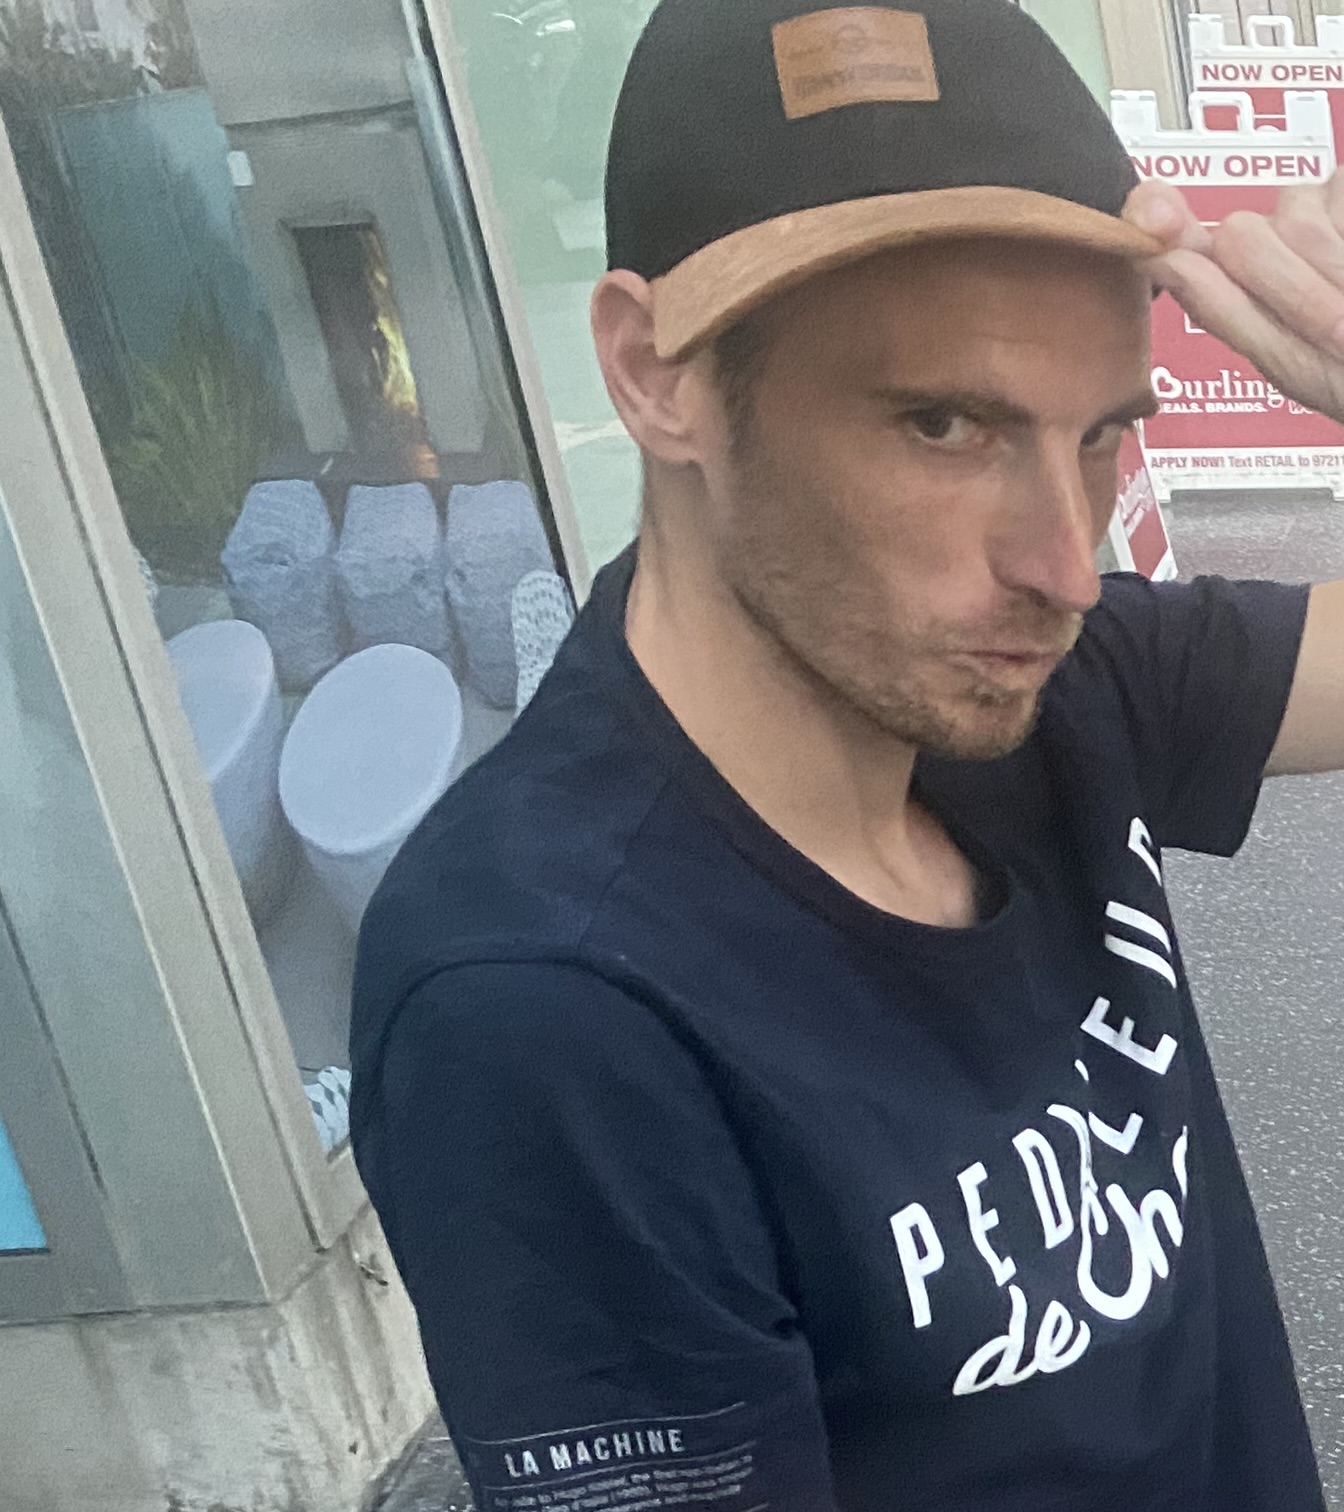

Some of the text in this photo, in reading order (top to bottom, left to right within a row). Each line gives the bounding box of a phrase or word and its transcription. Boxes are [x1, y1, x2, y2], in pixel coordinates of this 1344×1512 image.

[1202, 64, 1343, 81] NOW OPEN
[1129, 155, 1321, 177] NOW OPEN
[1151, 366, 1286, 408] Burling
[1159, 402, 1203, 413] EALS.
[1151, 456, 1187, 468] APPLY
[1255, 456, 1294, 467] RETAIL
[952, 1284, 1091, 1396] de
[504, 1429, 686, 1479] LA MACHINE
